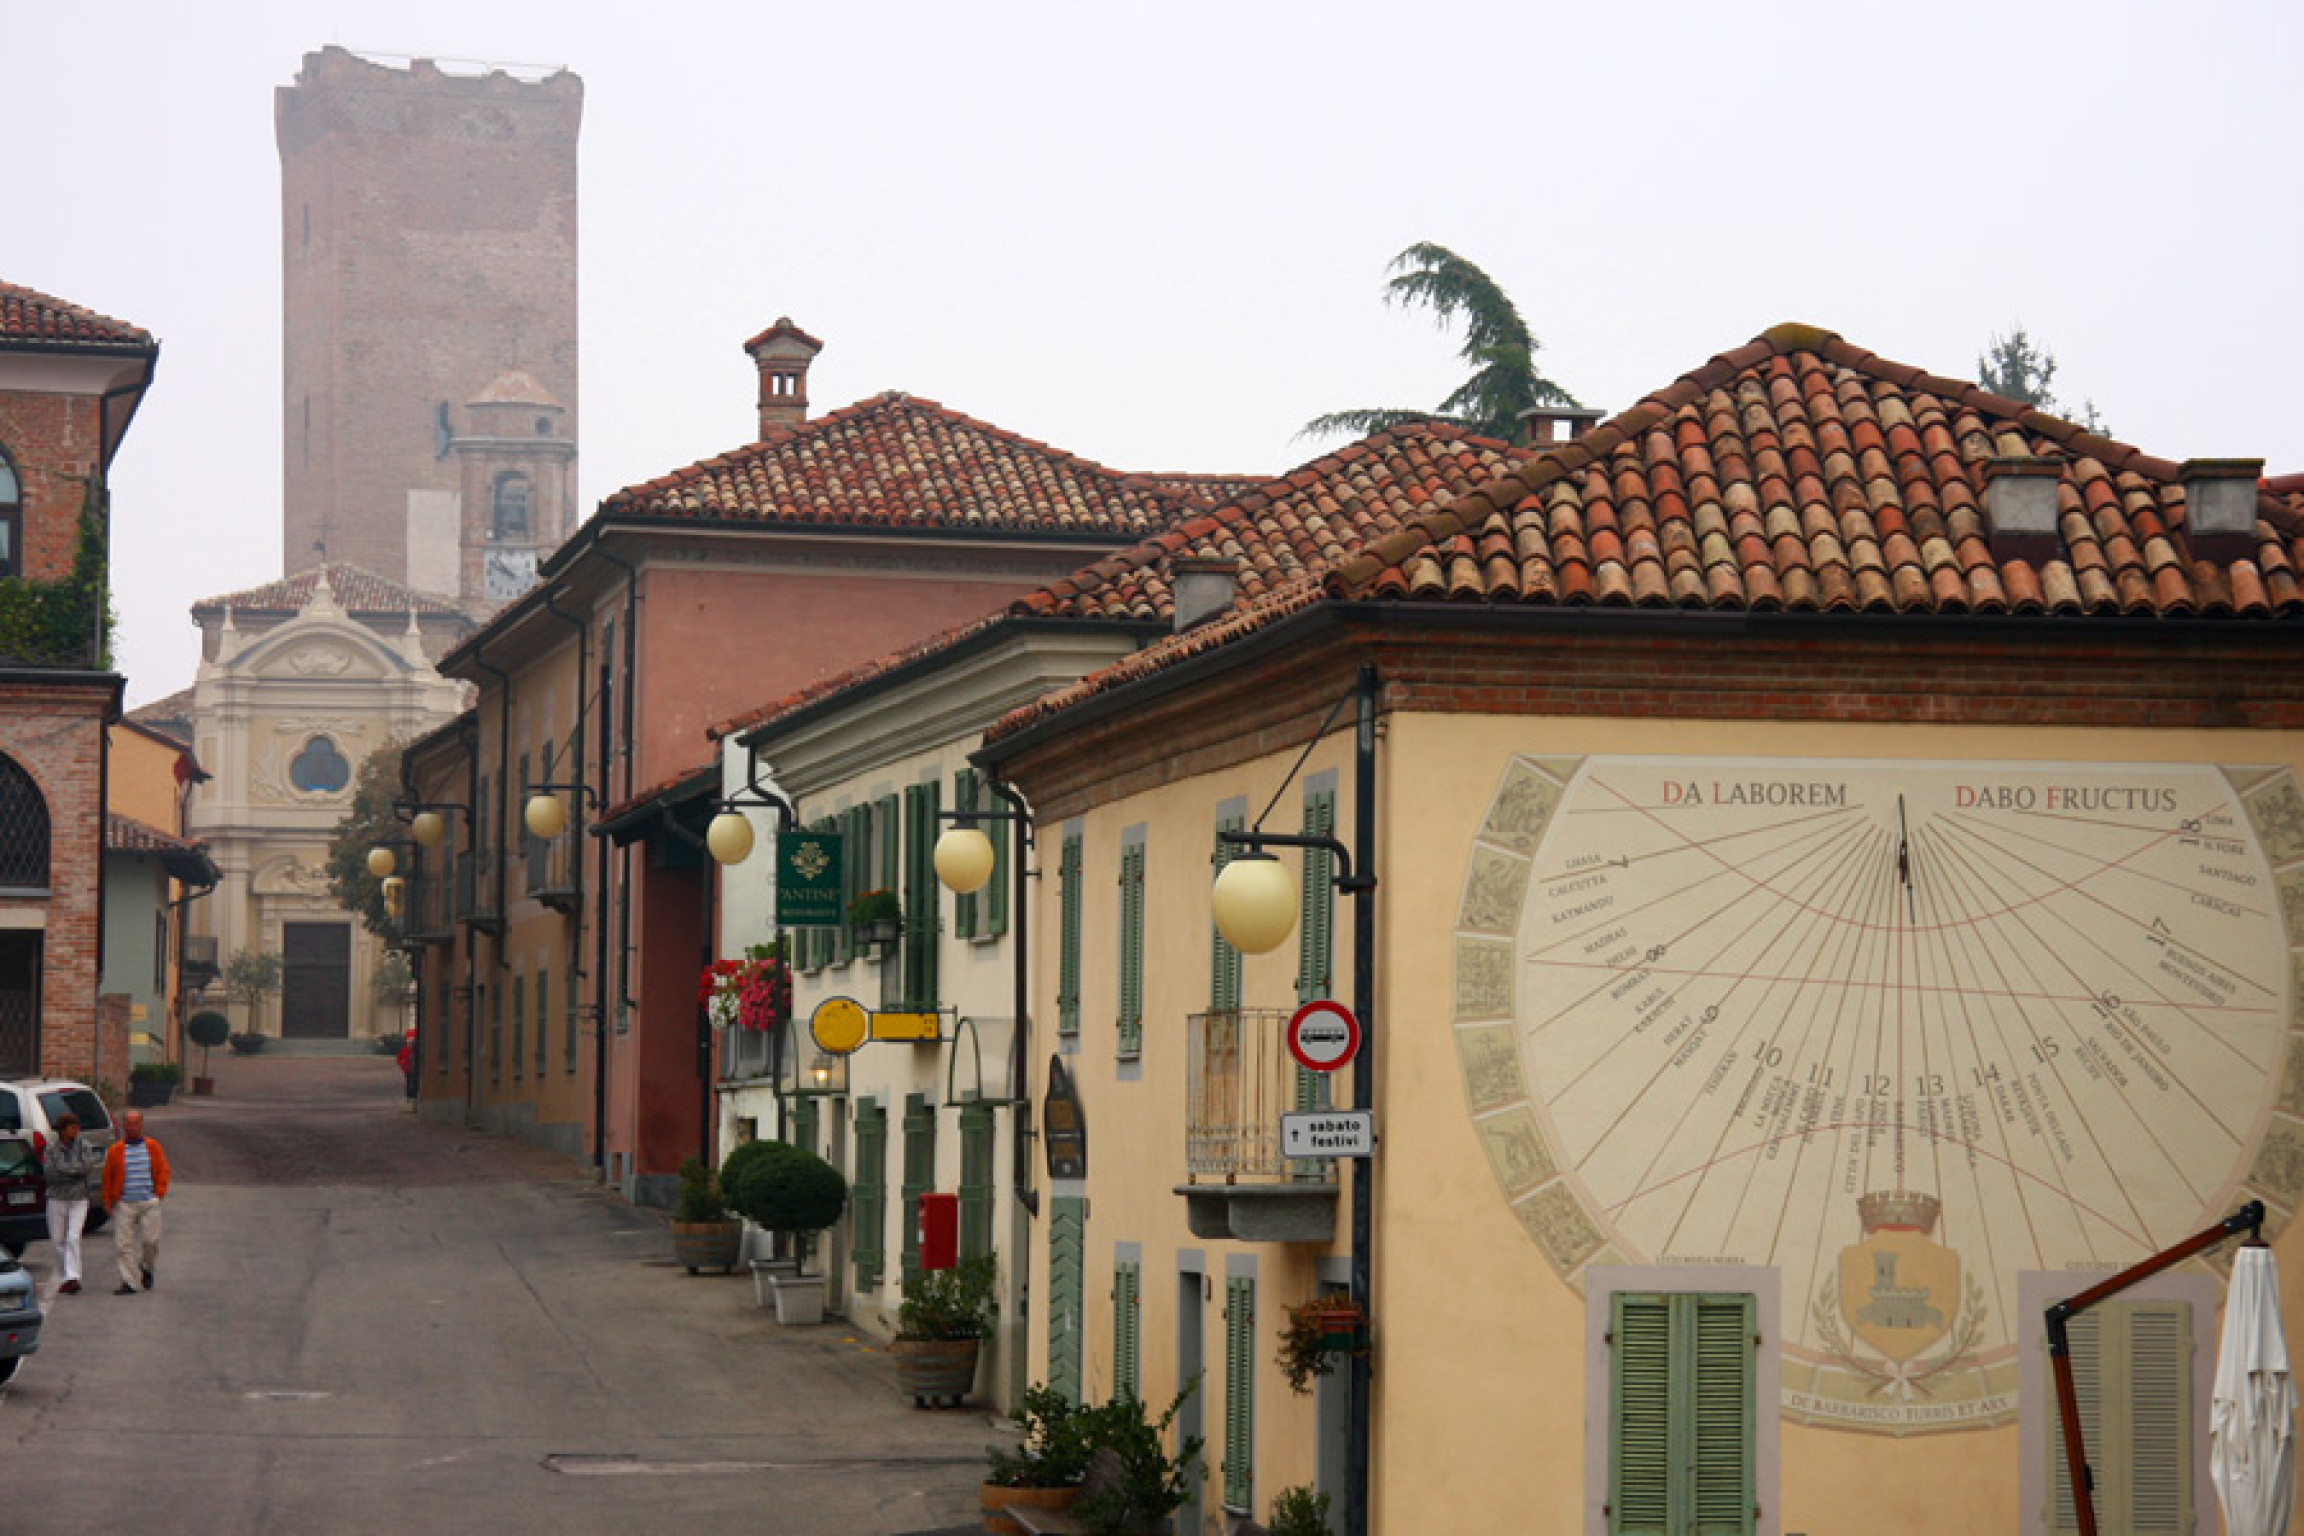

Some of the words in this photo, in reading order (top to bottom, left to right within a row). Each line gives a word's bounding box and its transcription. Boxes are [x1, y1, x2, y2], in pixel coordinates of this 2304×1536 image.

[1663, 780, 1703, 805] DA
[1713, 781, 1847, 806] LABOREM
[1955, 785, 2036, 810] DABO
[2046, 786, 2178, 812] FRUCTUS
[1548, 875, 1608, 898] CALCUTTA
[2198, 864, 2256, 887] SANTIAGO
[1754, 1041, 1783, 1068] 10
[2031, 1036, 2060, 1063] 15
[1809, 1062, 1834, 1088] 11
[1863, 1075, 1890, 1096] 12
[1917, 1075, 1944, 1096] 13
[1972, 1062, 2001, 1088] 14
[1309, 1119, 1361, 1132] sabato
[1311, 1135, 1360, 1147] festivi
